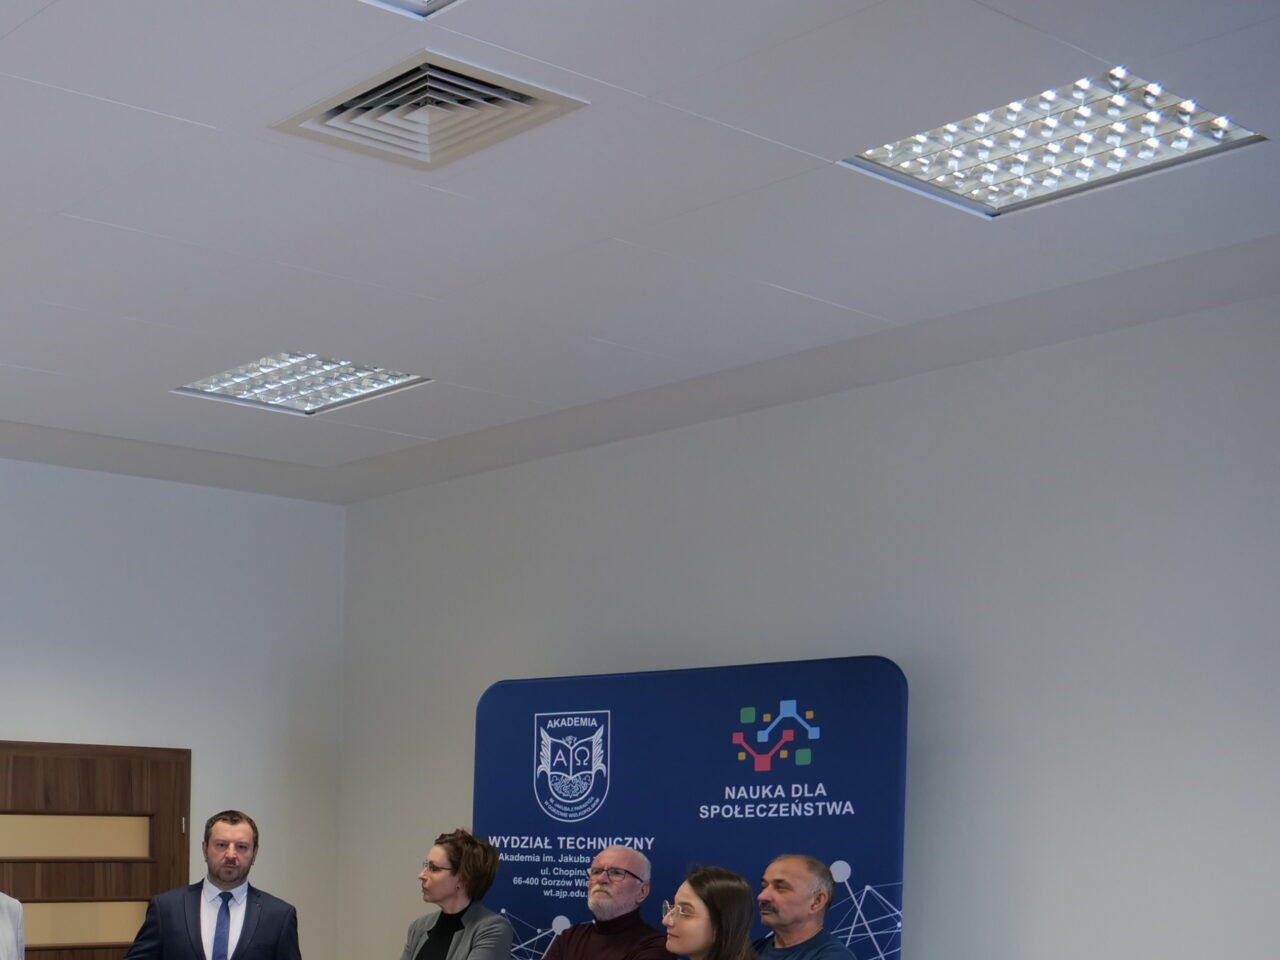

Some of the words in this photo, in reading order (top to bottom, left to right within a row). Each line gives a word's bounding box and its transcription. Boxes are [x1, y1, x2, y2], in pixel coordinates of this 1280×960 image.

[546, 717, 598, 729] AKADEMIA
[724, 784, 786, 800] NAUKA
[791, 783, 827, 798] DLA
[699, 800, 855, 819] SPOŁECZEŃSTWA
[488, 835, 553, 850] WYDZIAŁ
[557, 836, 655, 850] TECHNICZNY
[498, 852, 541, 863] Akademia
[542, 853, 556, 863] im.
[558, 853, 591, 864] Jakuba
[540, 866, 551, 876] ul.
[512, 877, 540, 886] 66-400
[541, 877, 572, 887] Gorzów
[543, 889, 588, 899] wt.ajp.edu.
